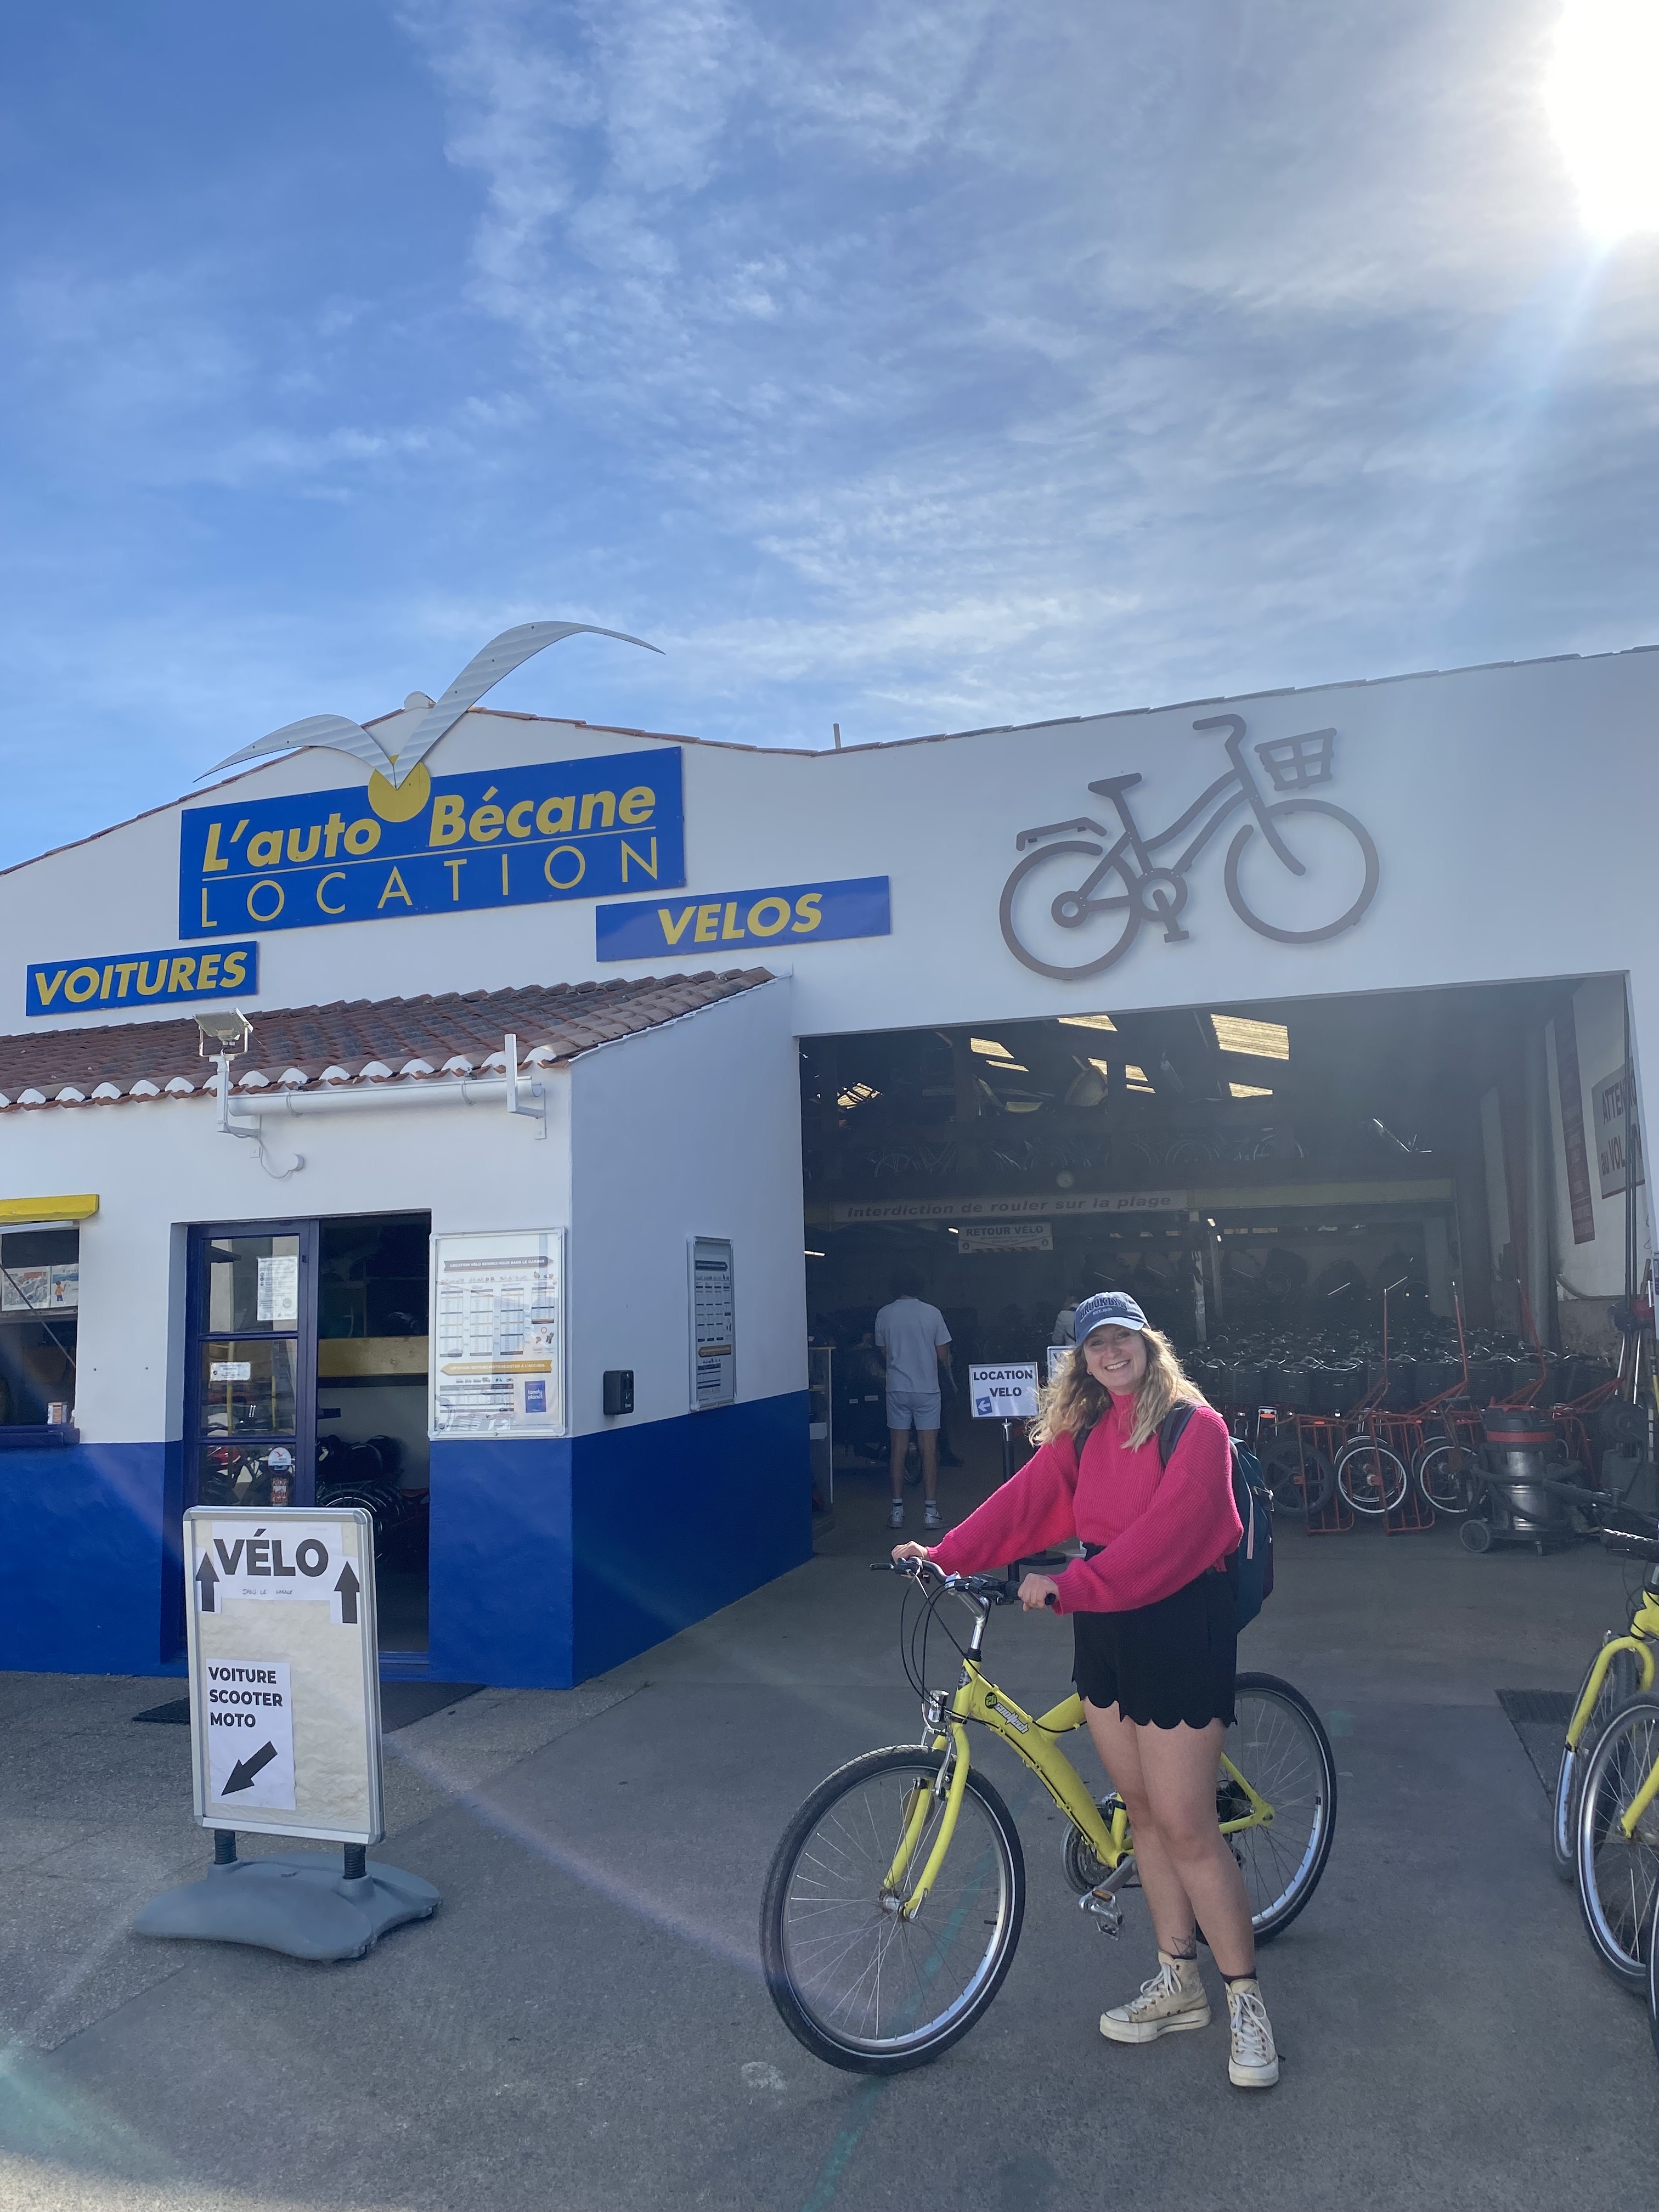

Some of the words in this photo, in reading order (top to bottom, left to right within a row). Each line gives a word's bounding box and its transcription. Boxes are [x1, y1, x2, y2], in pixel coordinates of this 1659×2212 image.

[429, 786, 656, 847] Bécane
[202, 837, 657, 927] LOCATION
[657, 893, 822, 945] VELOS
[35, 951, 247, 1005] VOITURES
[848, 1205, 953, 1217] Interdiction
[961, 1203, 983, 1213] de
[990, 1200, 1049, 1212] rouler
[1055, 1200, 1086, 1209] sur
[1093, 1198, 1110, 1208] la
[1116, 1195, 1171, 1209] plage
[966, 1227, 1011, 1237] RETOUR
[974, 1370, 1032, 1380] LOCATION
[990, 1387, 1022, 1397] VELO
[213, 1528, 329, 1577] VÉLO
[208, 1667, 276, 1684] VOITURE
[210, 1689, 283, 1707] SCOOTER
[210, 1712, 256, 1728] MOTO
